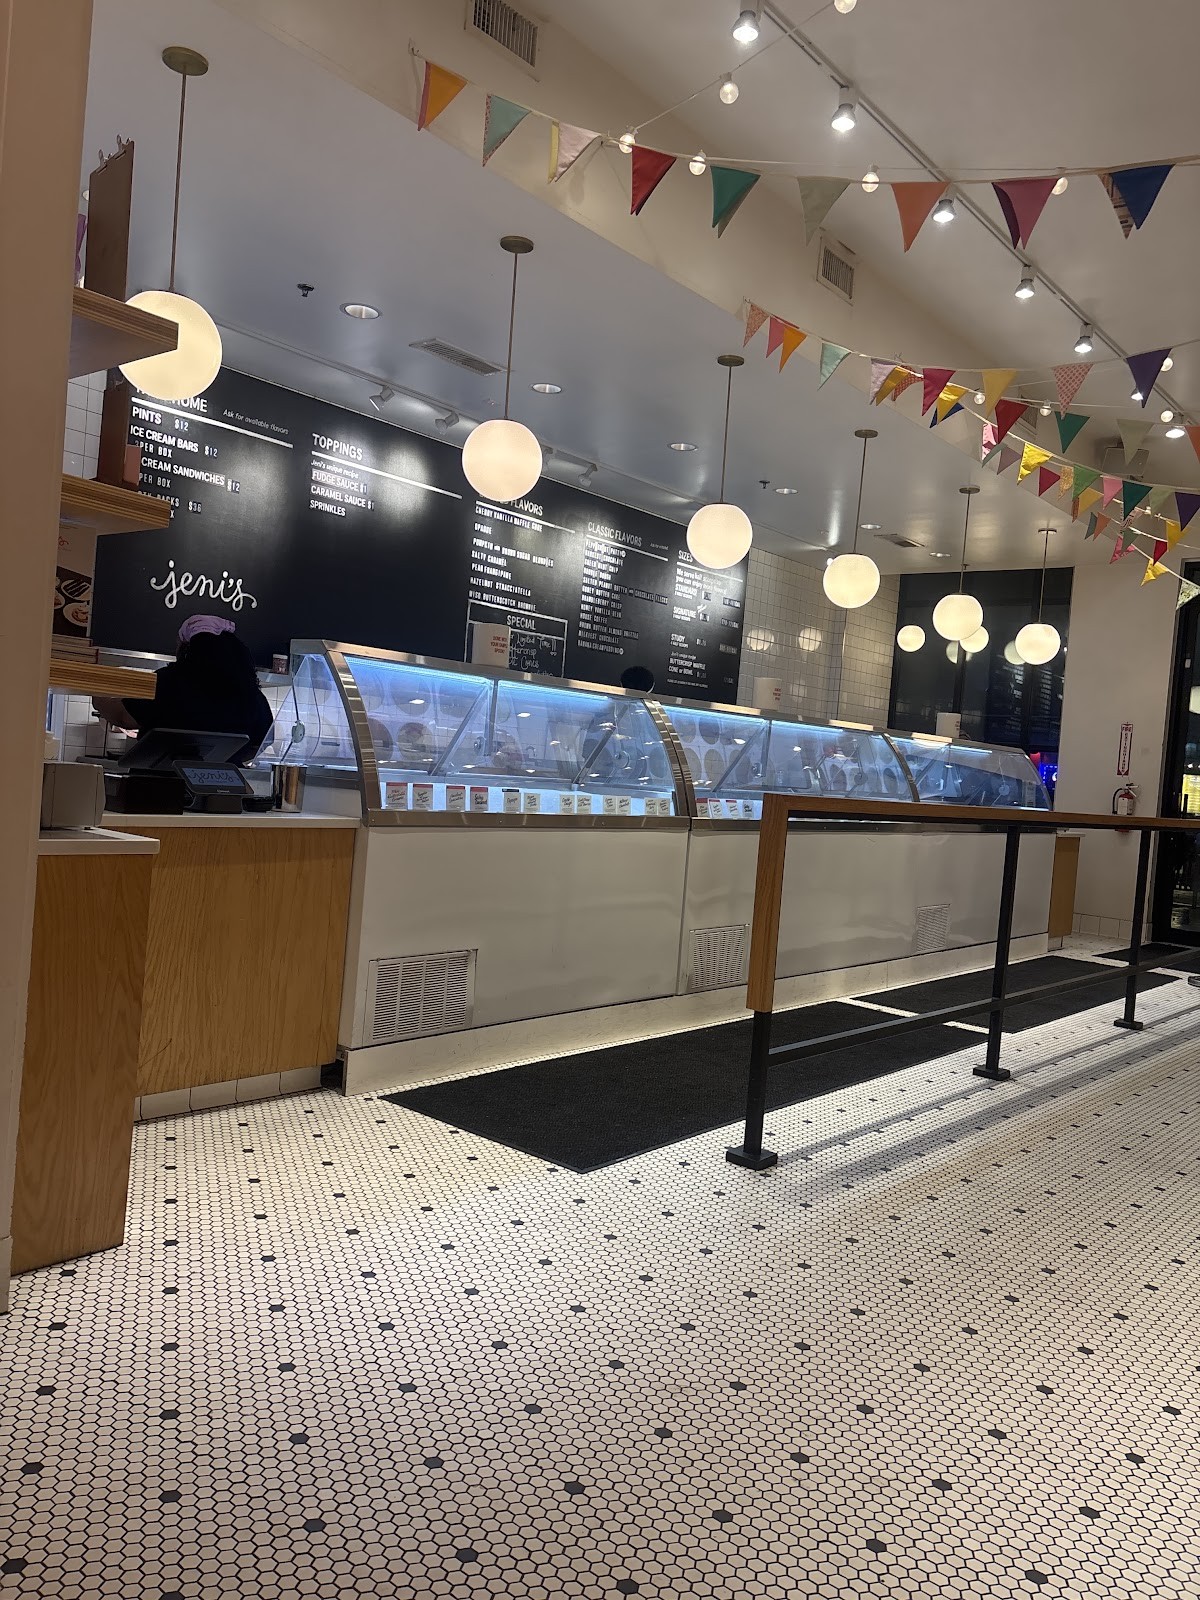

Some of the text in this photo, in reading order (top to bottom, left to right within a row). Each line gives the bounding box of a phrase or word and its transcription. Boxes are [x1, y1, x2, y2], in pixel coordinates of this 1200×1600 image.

[132, 406, 189, 431] PINTS $12
[223, 409, 234, 418] Ask
[245, 417, 269, 428] available
[270, 424, 289, 434] flavors
[130, 425, 218, 457] ICE CREAM BARS $12
[312, 432, 363, 460] TOPPINGS
[158, 446, 173, 458] BOX
[141, 457, 240, 492] CREAM SANDWICHES $12
[326, 465, 342, 474] unique
[343, 470, 359, 478] recipe
[139, 473, 171, 488] PER BOX
[312, 470, 336, 484] FUDGE
[336, 477, 359, 492] SAUCE
[311, 485, 344, 502] CARAMEL
[344, 494, 366, 508] SAUCE
[188, 502, 202, 512] $36
[310, 500, 346, 516] SPRINKLES
[511, 499, 544, 516] FLAVORS
[587, 522, 614, 538] CLASSIC
[615, 530, 642, 547] FLAVORS
[678, 550, 693, 562] SIZES
[150, 560, 258, 612] jeni's
[506, 614, 536, 630] SPECIAL
[671, 633, 686, 642] STUDY
[188, 769, 240, 784] jeni's
